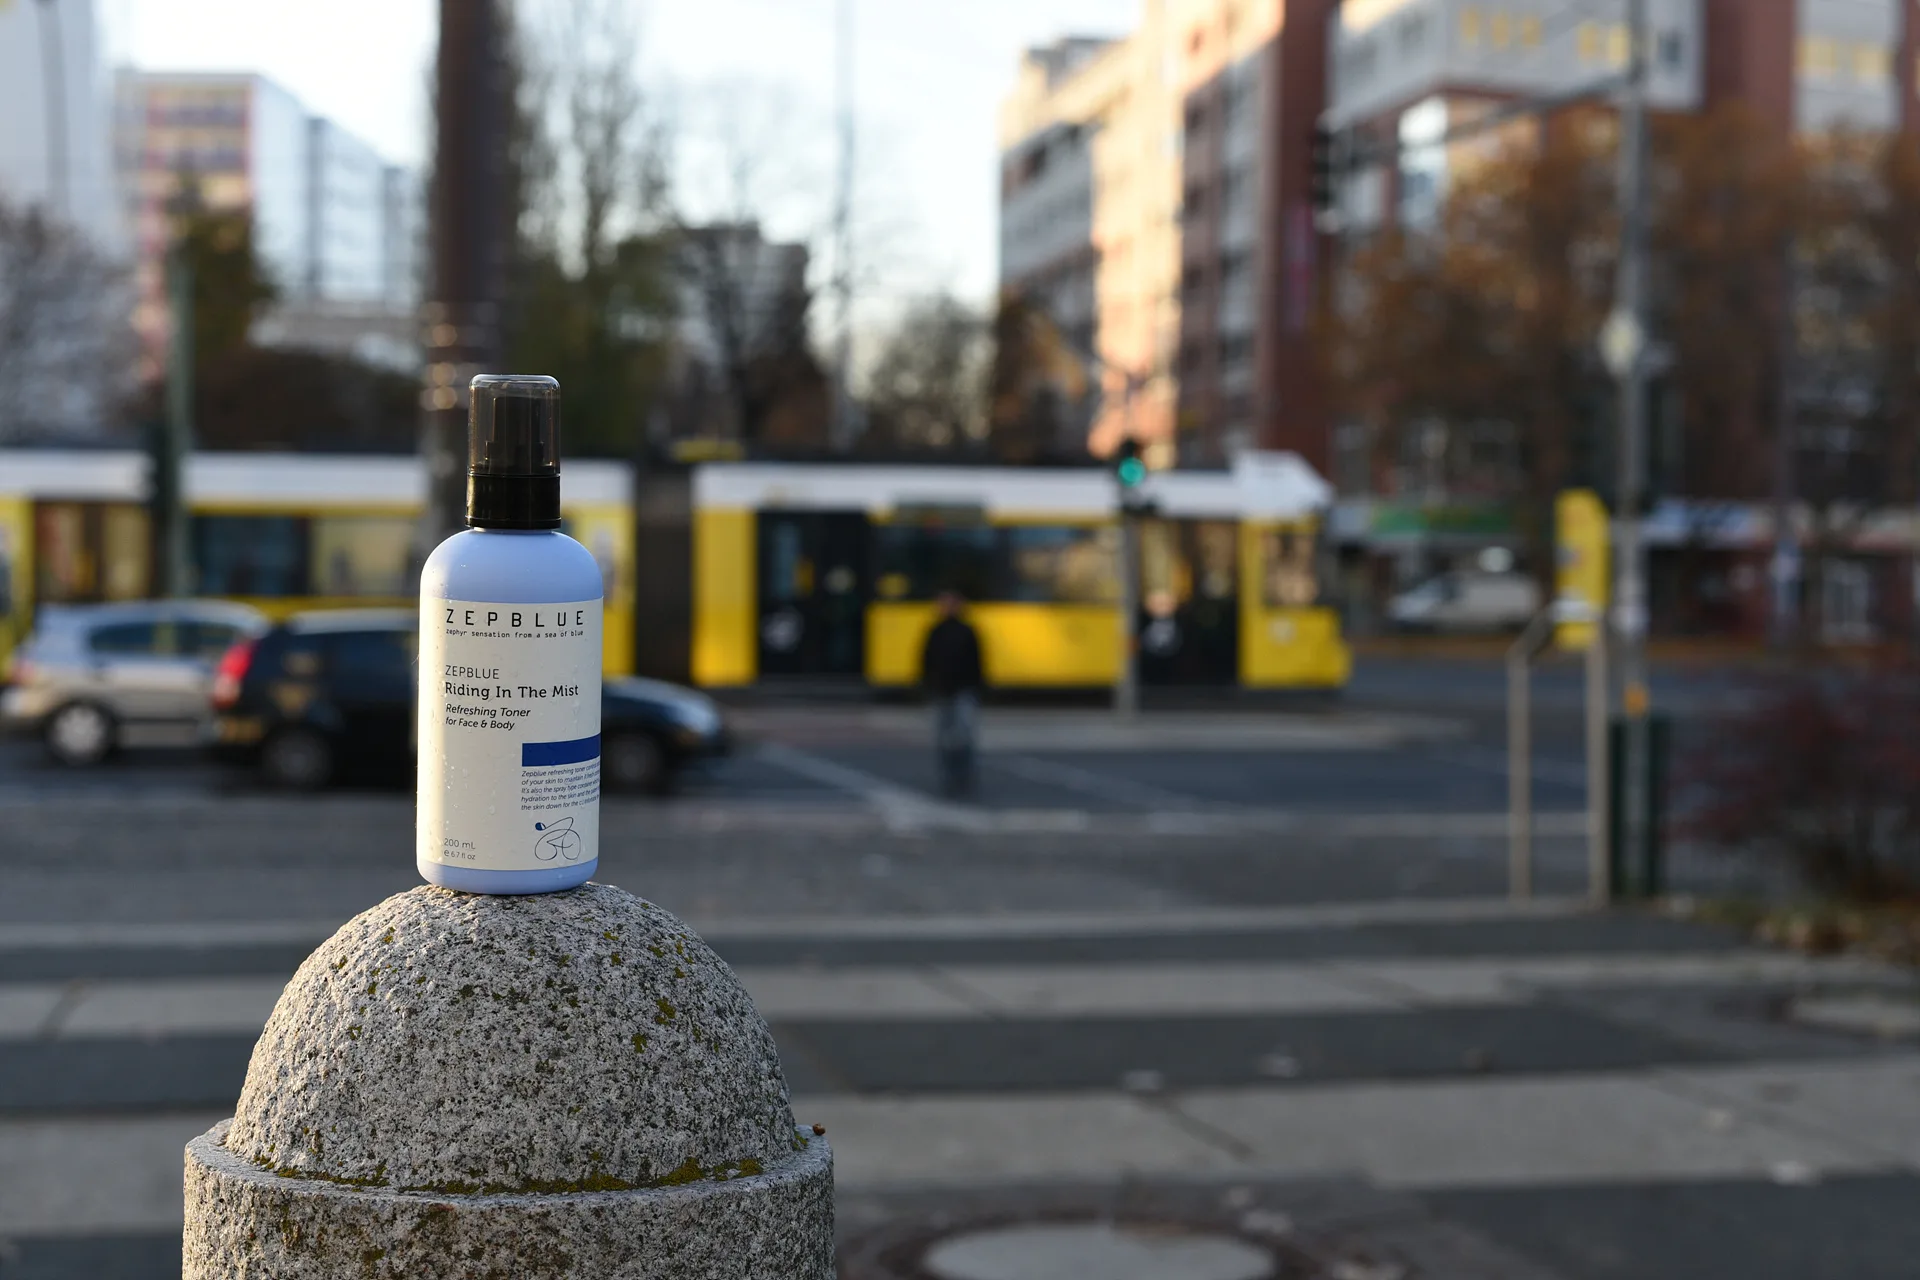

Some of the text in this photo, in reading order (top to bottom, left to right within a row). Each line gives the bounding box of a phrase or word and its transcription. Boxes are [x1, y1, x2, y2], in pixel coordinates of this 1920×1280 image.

[446, 608, 584, 628] ZEPBLUE
[446, 628, 468, 637] zephyr
[471, 630, 510, 638] sensation
[445, 664, 500, 679] ZEPBLUE
[445, 681, 579, 700] Riding In The Mist
[445, 703, 531, 719] Refreshing Toner
[445, 716, 515, 731] for Face & Body
[547, 768, 574, 776] refreshing
[553, 785, 567, 793] spray
[444, 837, 476, 850] 200 mL
[450, 850, 460, 858] 67
